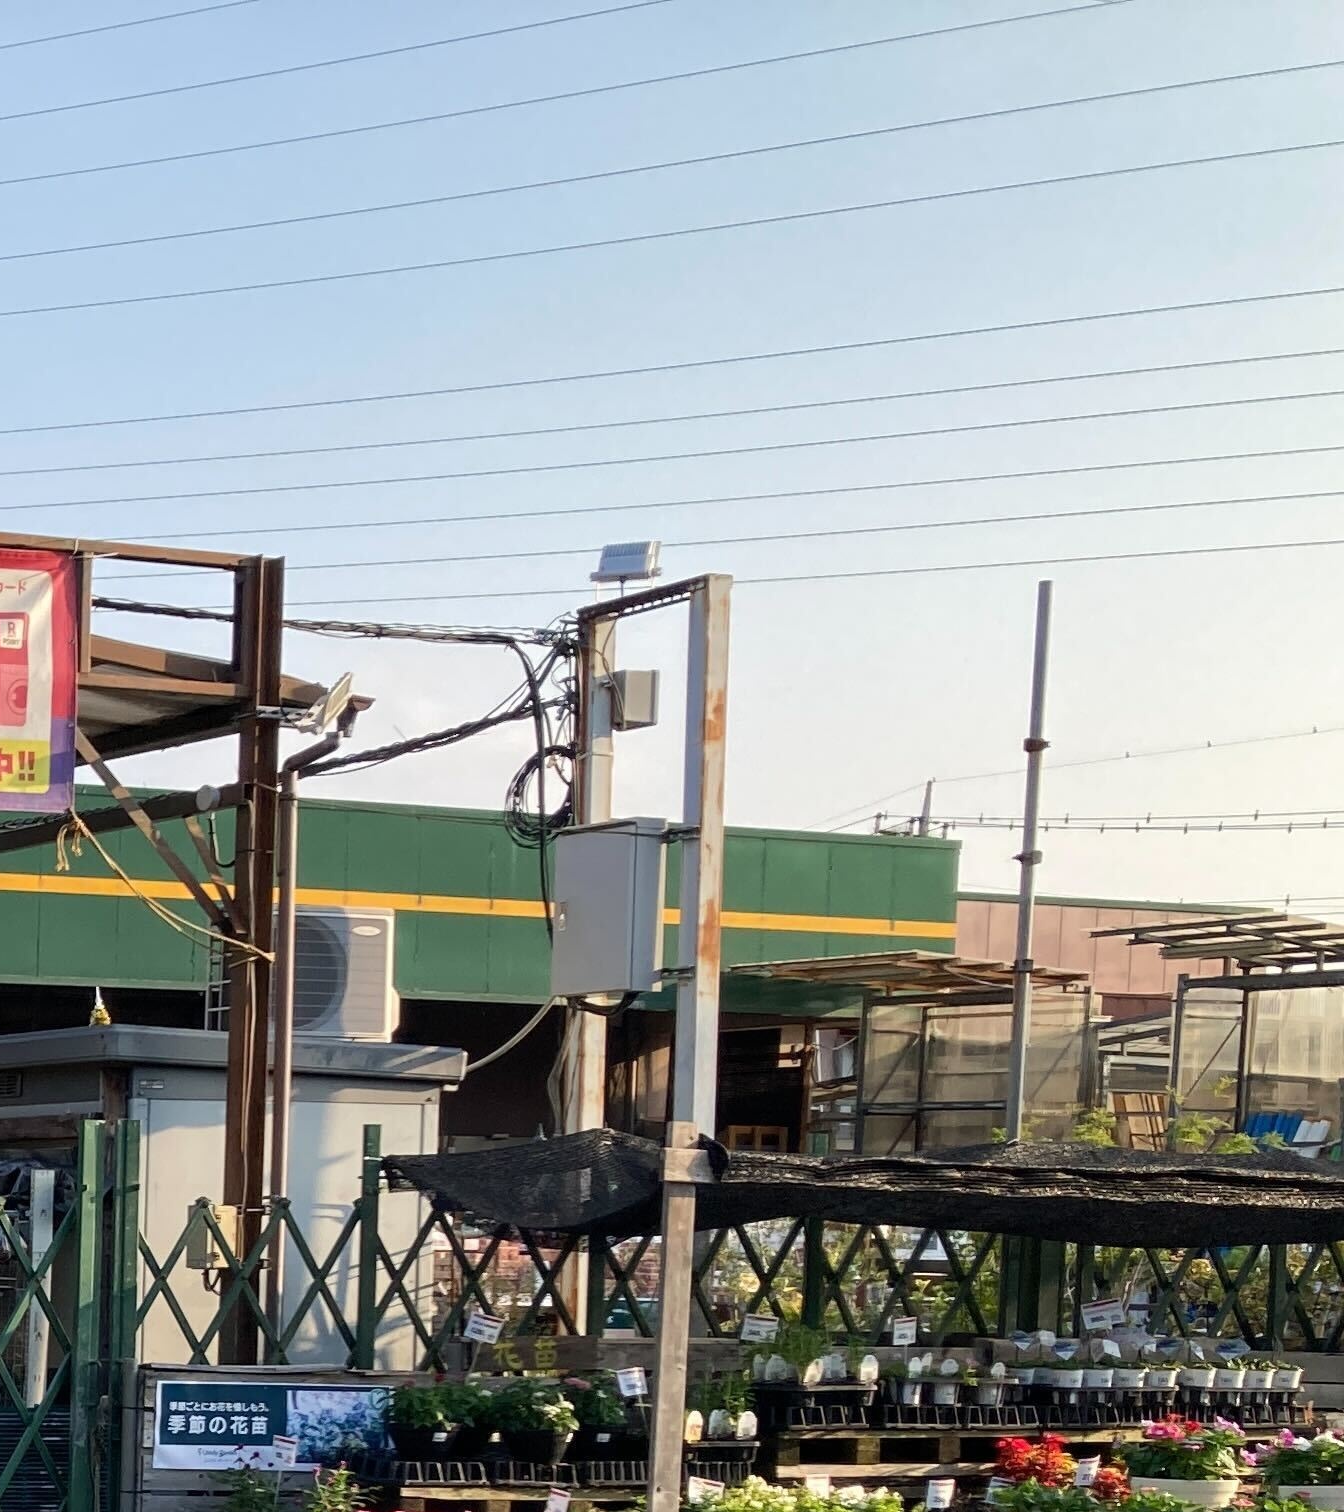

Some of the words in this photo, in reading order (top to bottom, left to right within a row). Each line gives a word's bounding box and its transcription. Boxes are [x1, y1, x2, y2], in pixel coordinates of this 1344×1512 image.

[493, 1338, 558, 1371] 花苗
[168, 1414, 269, 1435] 季節の花苗
